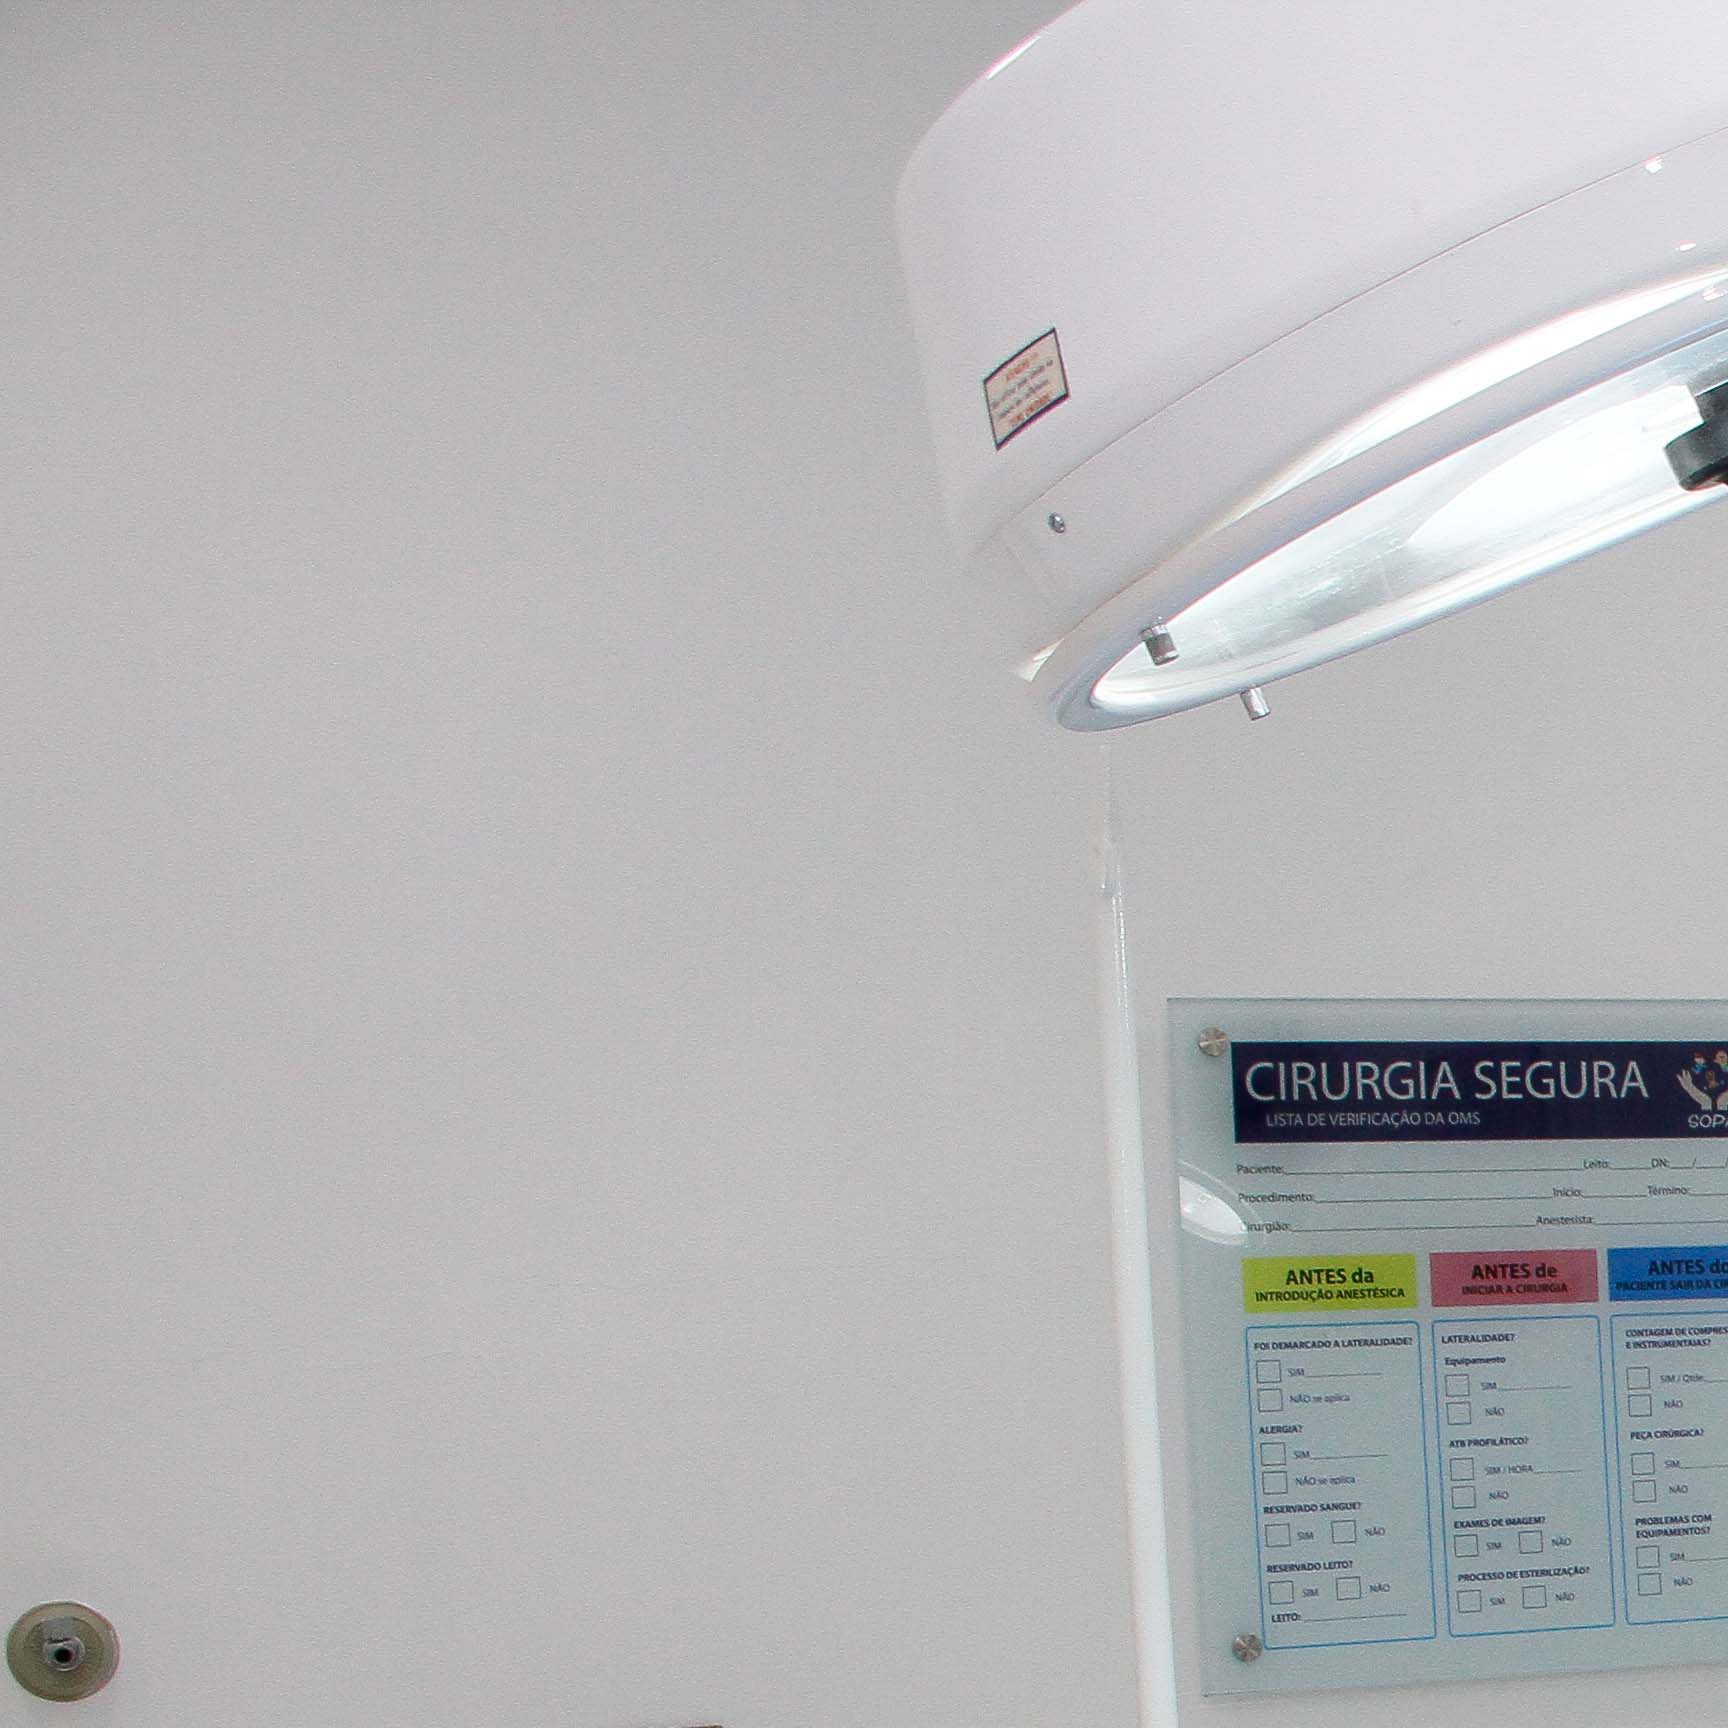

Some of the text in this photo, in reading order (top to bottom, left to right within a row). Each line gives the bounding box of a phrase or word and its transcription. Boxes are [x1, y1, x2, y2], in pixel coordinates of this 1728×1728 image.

[1245, 1059, 1650, 1101] CIRURGIA SEGURA
[1266, 1108, 1481, 1128] LISTA DE VERIFICAÇÃO DA OMS
[1244, 1221, 1291, 1234] irurgião:
[1471, 1262, 1558, 1279] ANTES de
[1648, 1259, 1705, 1275] ANTES
[1285, 1266, 1374, 1285] ANTES da
[1616, 1280, 1667, 1291] PACIENTE
[1696, 1279, 1712, 1290] DA
[1255, 1286, 1406, 1303] INTRODUÇÃO ANESTÉSICA
[1625, 1327, 1674, 1338] CONTAGEM
[1675, 1326, 1687, 1336] DE
[1272, 1340, 1331, 1349] DEMARCADO
[1333, 1340, 1340, 1348] A
[1441, 1333, 1516, 1344] LATERALIDADE?
[1625, 1341, 1632, 1350] E
[1445, 1356, 1506, 1366] Equipamento
[1259, 1425, 1303, 1434] ALERGIA?
[1630, 1431, 1653, 1441] PEÇA
[1263, 1504, 1318, 1514] RESERVADO
[1454, 1519, 1490, 1529] EXAMES
[1491, 1518, 1503, 1527] DE
[1635, 1514, 1713, 1526] PROBLEMAS COM
[1636, 1527, 1711, 1539] EQUIPAMENTOS?
[1266, 1560, 1353, 1573] RESERVADO LEITO?
[1457, 1572, 1504, 1582] PROCESSO
[1506, 1571, 1519, 1580] DE
[1271, 1613, 1300, 1623] LEITO:
